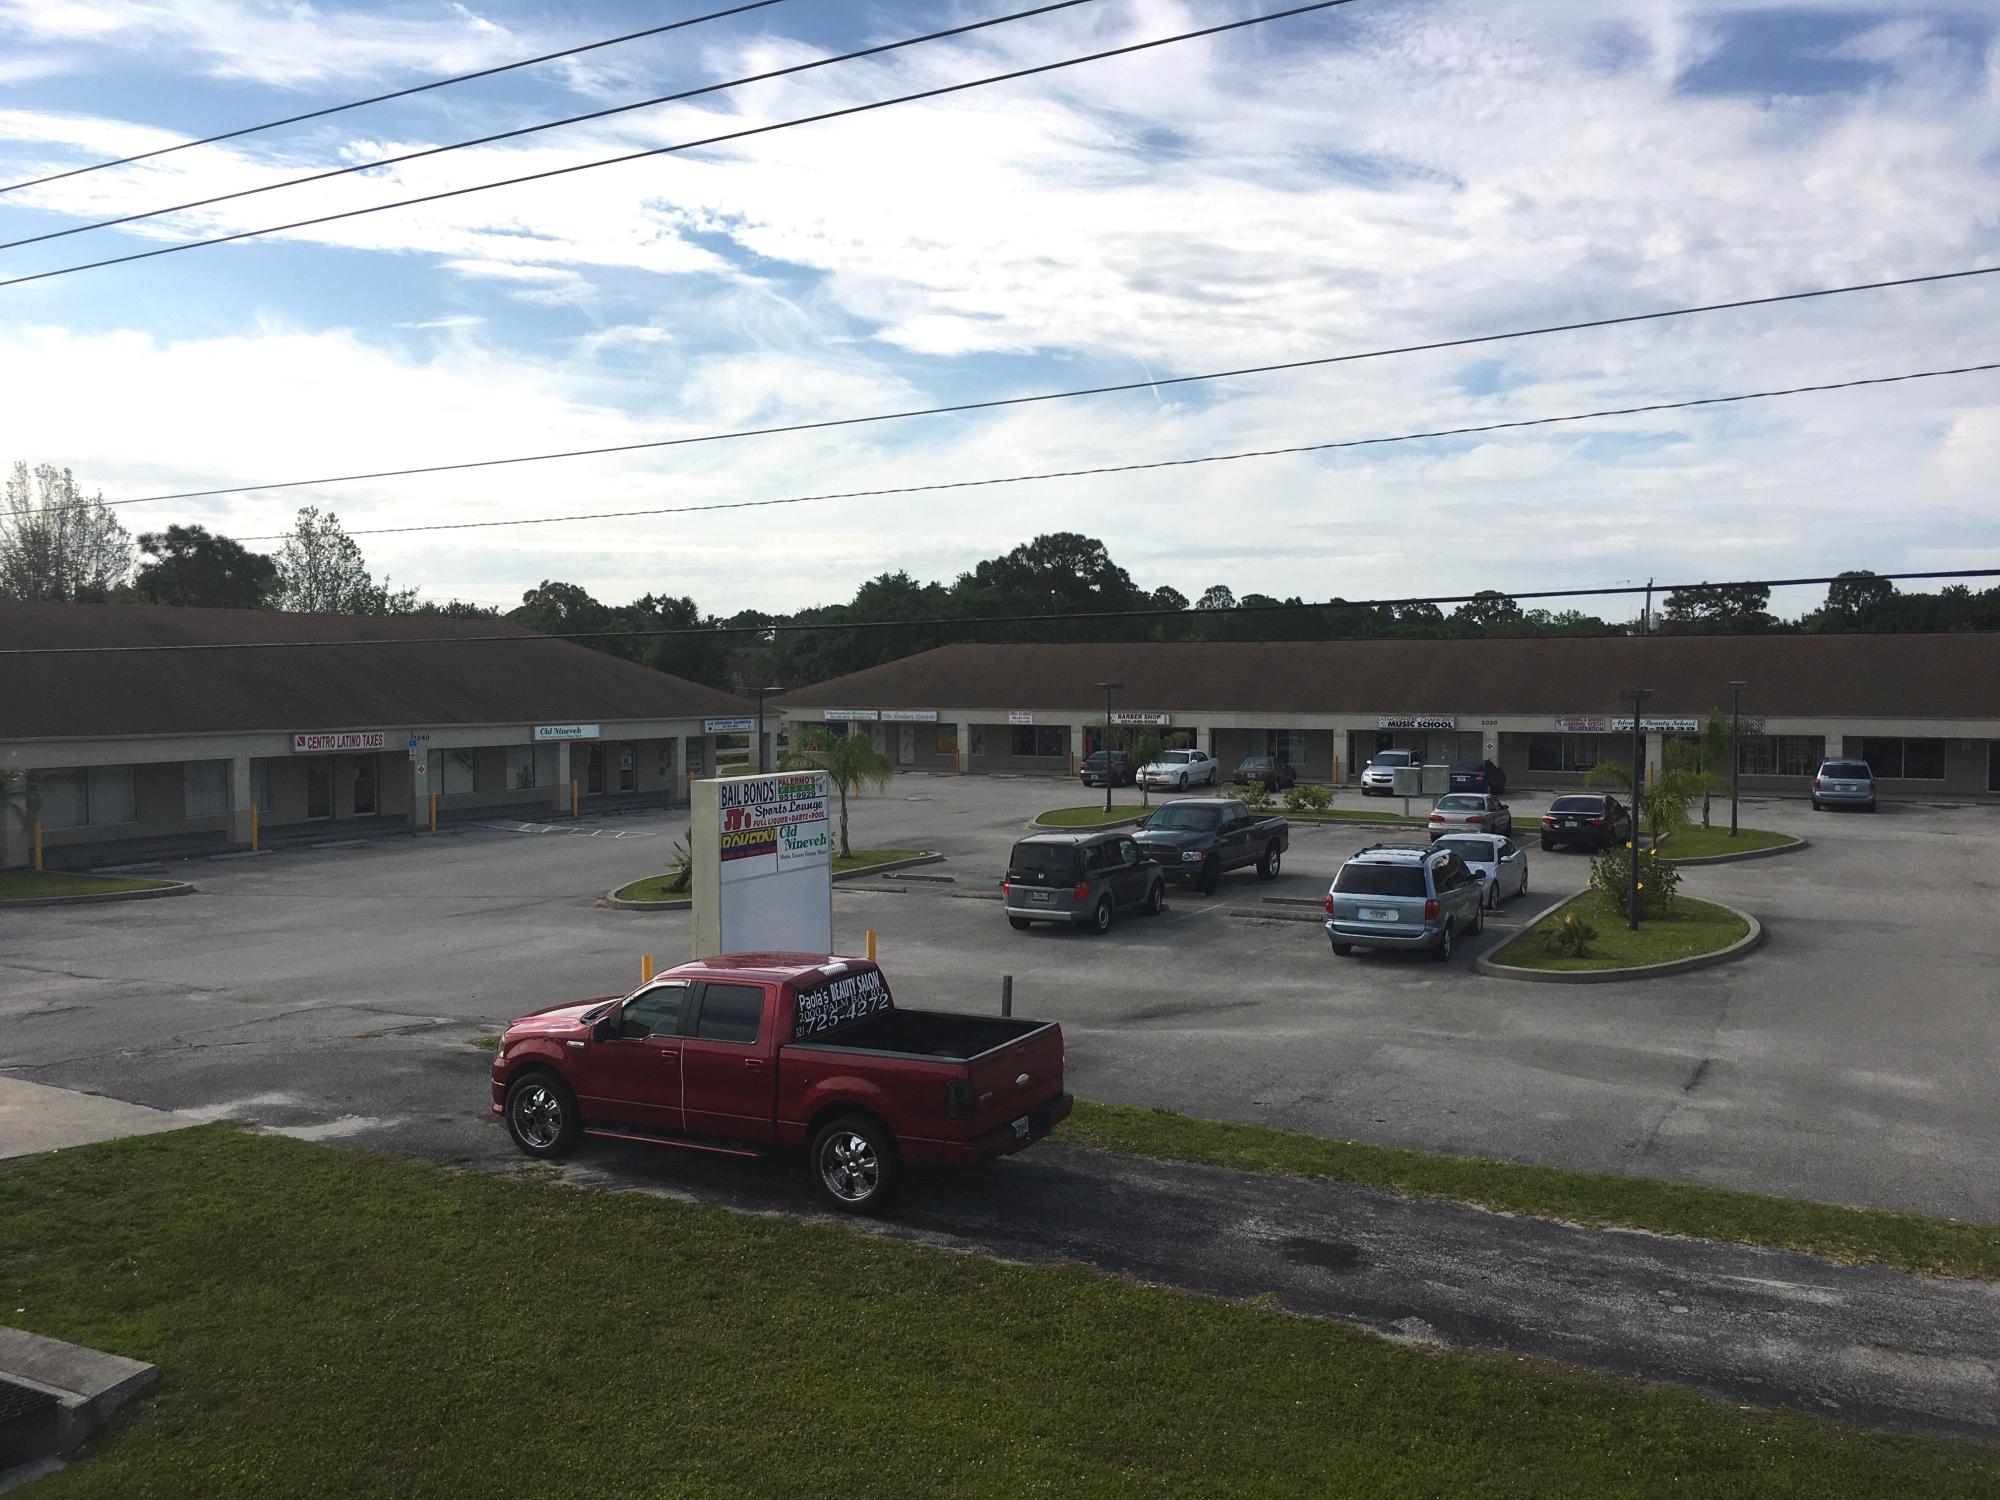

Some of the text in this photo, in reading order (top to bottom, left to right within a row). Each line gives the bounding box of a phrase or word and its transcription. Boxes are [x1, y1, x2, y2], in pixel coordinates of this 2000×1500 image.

[540, 727, 553, 735] Old
[554, 726, 582, 736] Nineveh
[1645, 719, 1669, 727] Beauty
[307, 733, 383, 749] CENTRO LATINO TAXES
[778, 776, 816, 787] PALERMO'S
[722, 780, 774, 807] BAIL BONDS
[753, 810, 825, 828] FULL LIQUOR DARTS POOL
[755, 804, 787, 819] Sports
[788, 801, 823, 813] Lounge
[780, 825, 797, 839] Old
[785, 833, 827, 851] Nineveh
[798, 971, 880, 1012] Paola's BEAUTY SALON
[798, 986, 884, 1023] 2000 PALM BAY RD
[805, 993, 888, 1034] 725-4272
